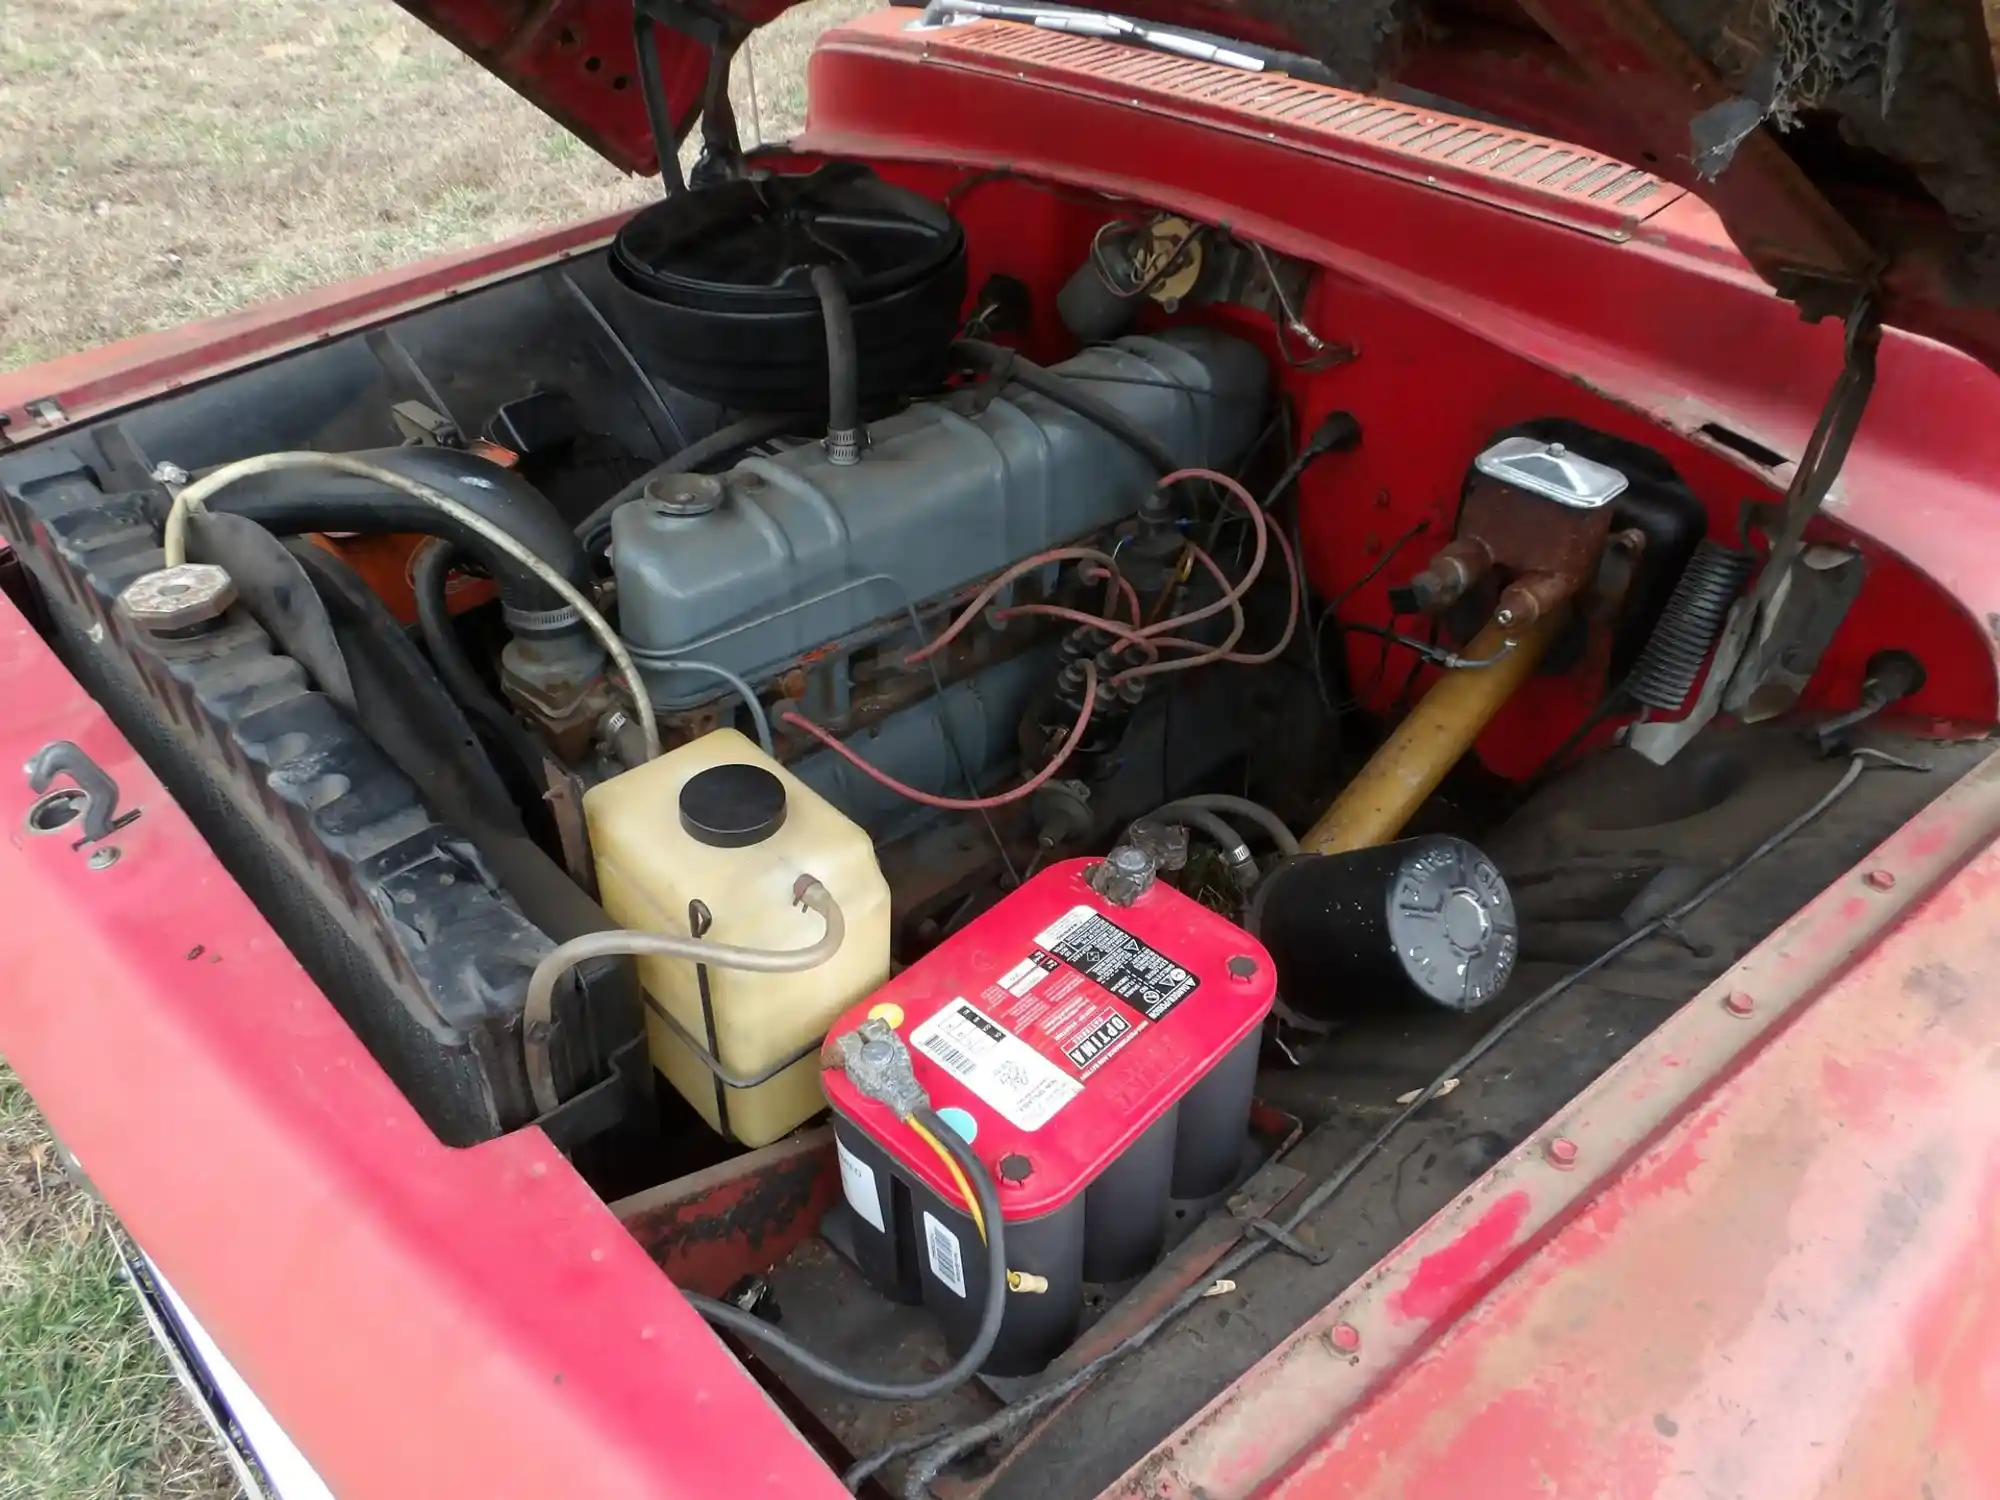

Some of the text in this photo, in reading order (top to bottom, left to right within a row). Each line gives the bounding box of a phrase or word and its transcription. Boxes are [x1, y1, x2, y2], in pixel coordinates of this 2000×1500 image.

[1409, 945, 1439, 986] OIL
[1147, 982, 1190, 1020] DANGER/POISON
[1069, 1014, 1128, 1065] OPTIMA
